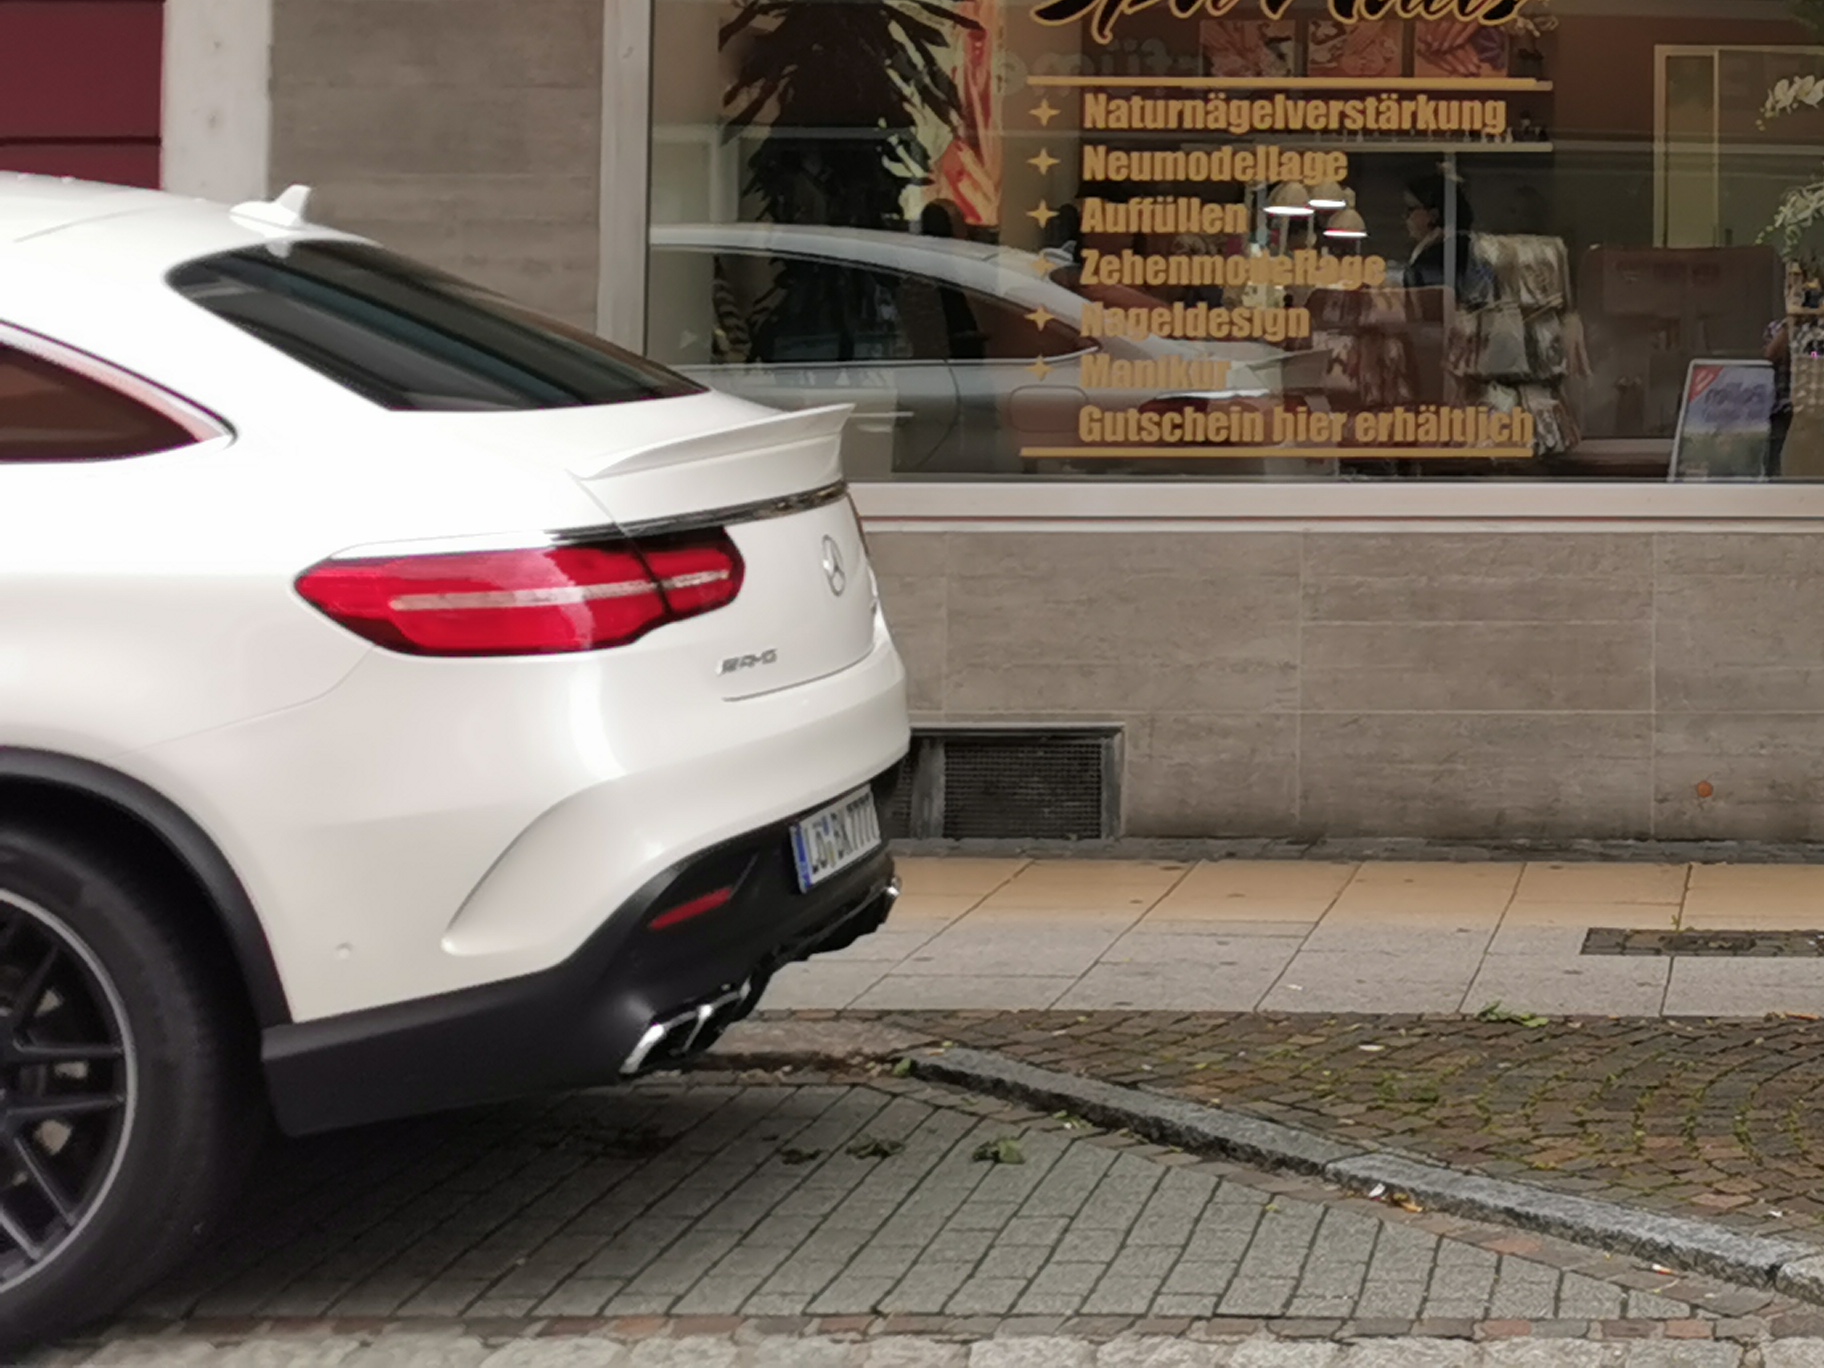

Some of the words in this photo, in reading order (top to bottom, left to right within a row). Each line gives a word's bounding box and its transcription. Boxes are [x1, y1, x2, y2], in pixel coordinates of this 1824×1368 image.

[1083, 92, 1507, 135] Naturnägelverstärkung
[1082, 143, 1349, 186] Neumodellage
[1080, 195, 1248, 234] Auffüllen
[1079, 248, 1386, 290] Zehenmodellage
[1079, 301, 1311, 341] Nageldesign
[1078, 404, 1264, 444] Gutschein
[1272, 404, 1348, 444] hier
[1354, 404, 1534, 444] erhältlich
